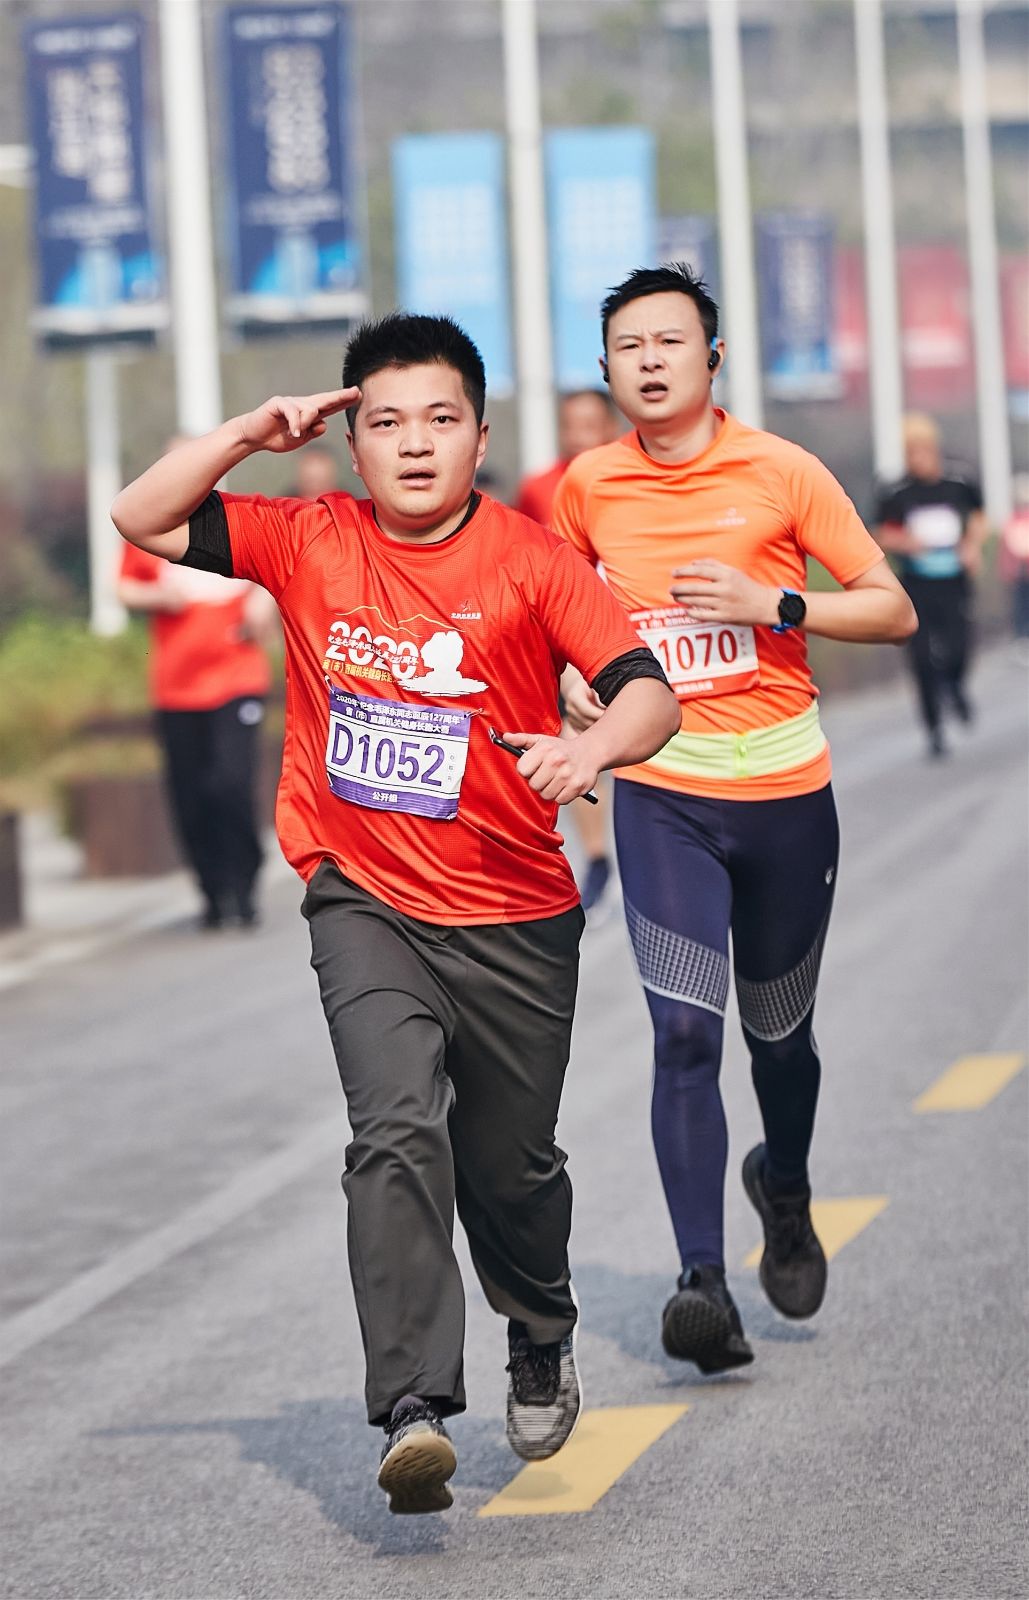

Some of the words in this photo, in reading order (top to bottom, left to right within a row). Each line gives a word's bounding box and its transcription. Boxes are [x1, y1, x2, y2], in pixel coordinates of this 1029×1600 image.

[325, 621, 419, 679] 2020
[659, 629, 737, 673] 1070
[330, 722, 445, 787] D1052
[372, 791, 398, 803] 公开组
